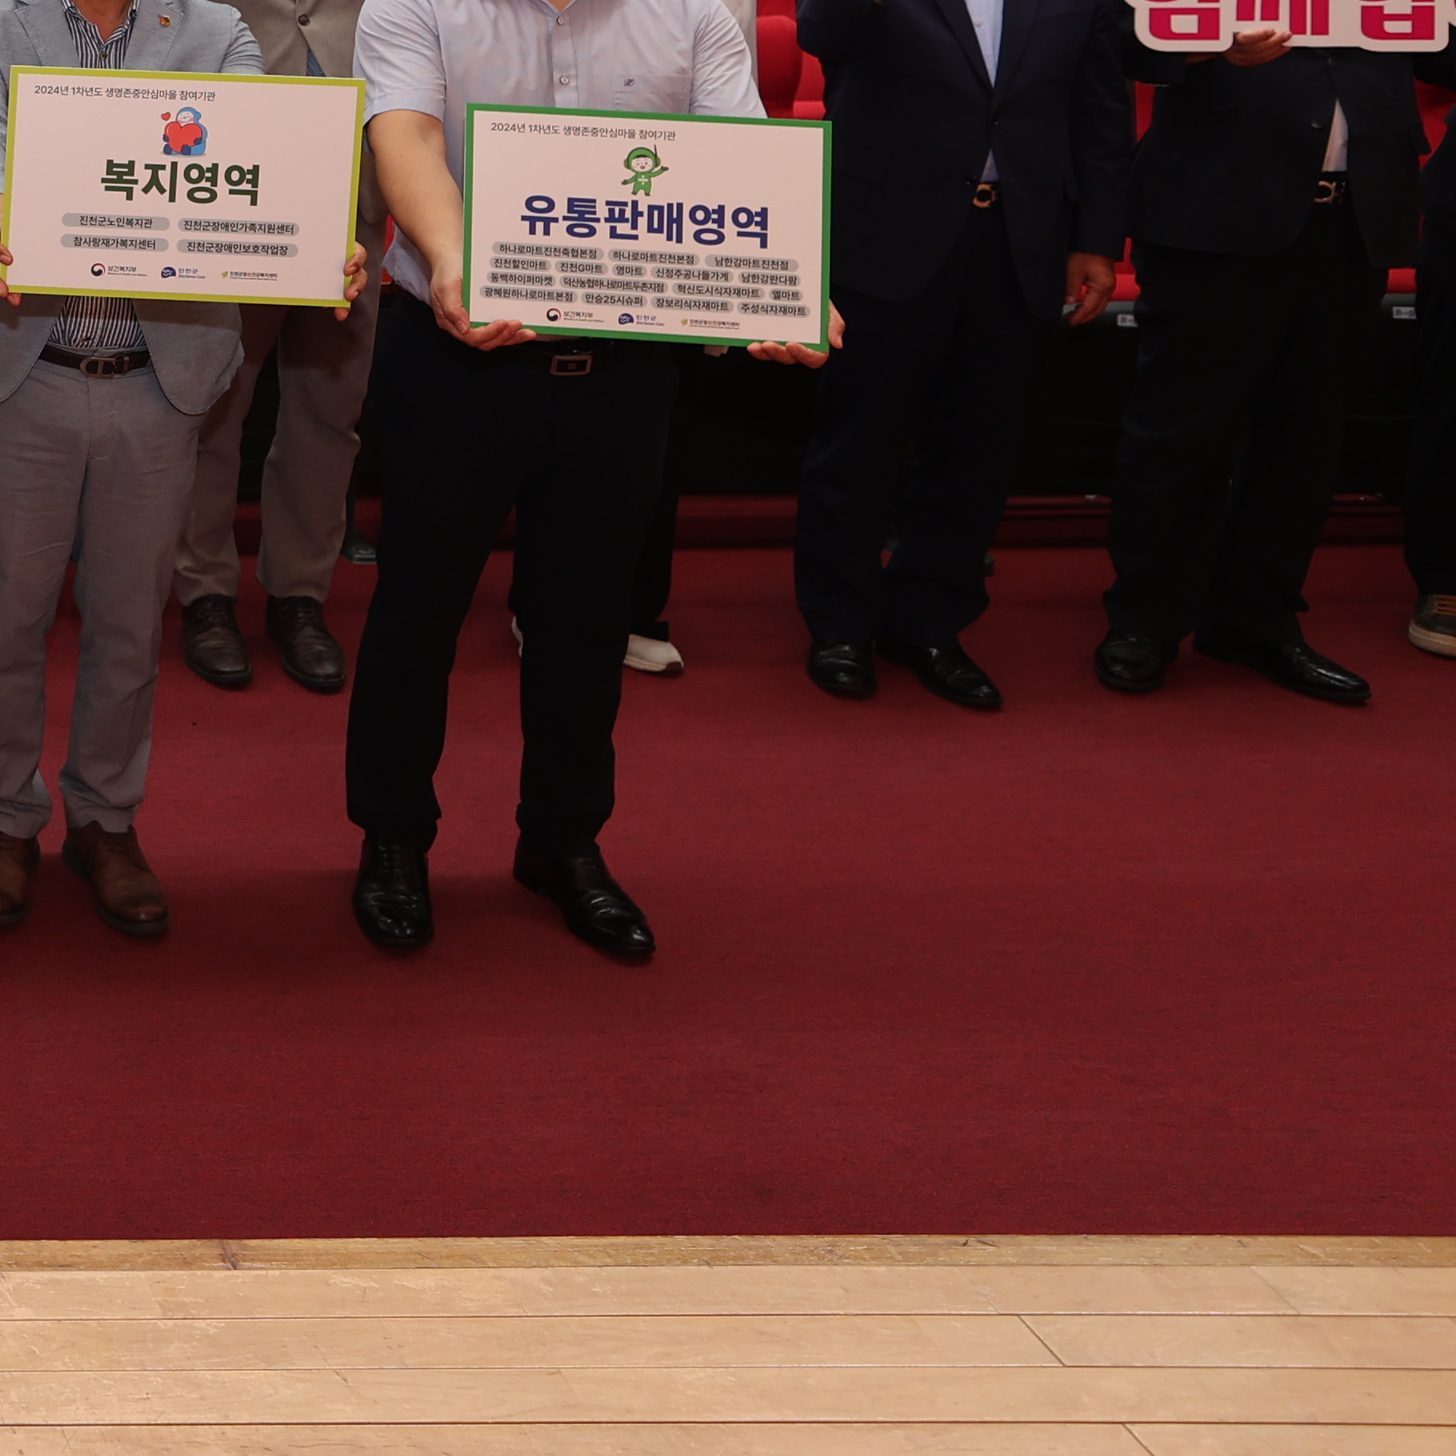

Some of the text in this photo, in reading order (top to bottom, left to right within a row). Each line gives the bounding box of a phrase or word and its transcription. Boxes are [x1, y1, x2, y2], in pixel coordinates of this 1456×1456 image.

[34, 84, 216, 102] 2024년 1차년도 생명존중안심마을 참여기관
[490, 122, 676, 141] 2024년 1차년도 생명존중안심마을 참여기관
[100, 159, 260, 206] 복지영역
[79, 215, 294, 235] 진천군노인복지관 진천군장애인가족지원센터
[520, 195, 769, 249] 유통판매영역
[73, 236, 288, 256] 참사랑재가복지센터 진천군장애인보호작업장
[499, 244, 788, 271] 하나로마트진천축협본점 하나로마트진천본점 남한강마트진천점
[494, 258, 547, 270] 진천할인마트
[560, 262, 603, 274] 진천G마트
[656, 268, 729, 282] 신정주공나들가게
[484, 288, 573, 302] 광혜원하나로마트본점
[656, 298, 729, 311] 장보리식자재마트
[741, 304, 807, 316] 주성식자재마트
[677, 284, 760, 298] 혁신도시식자재마트
